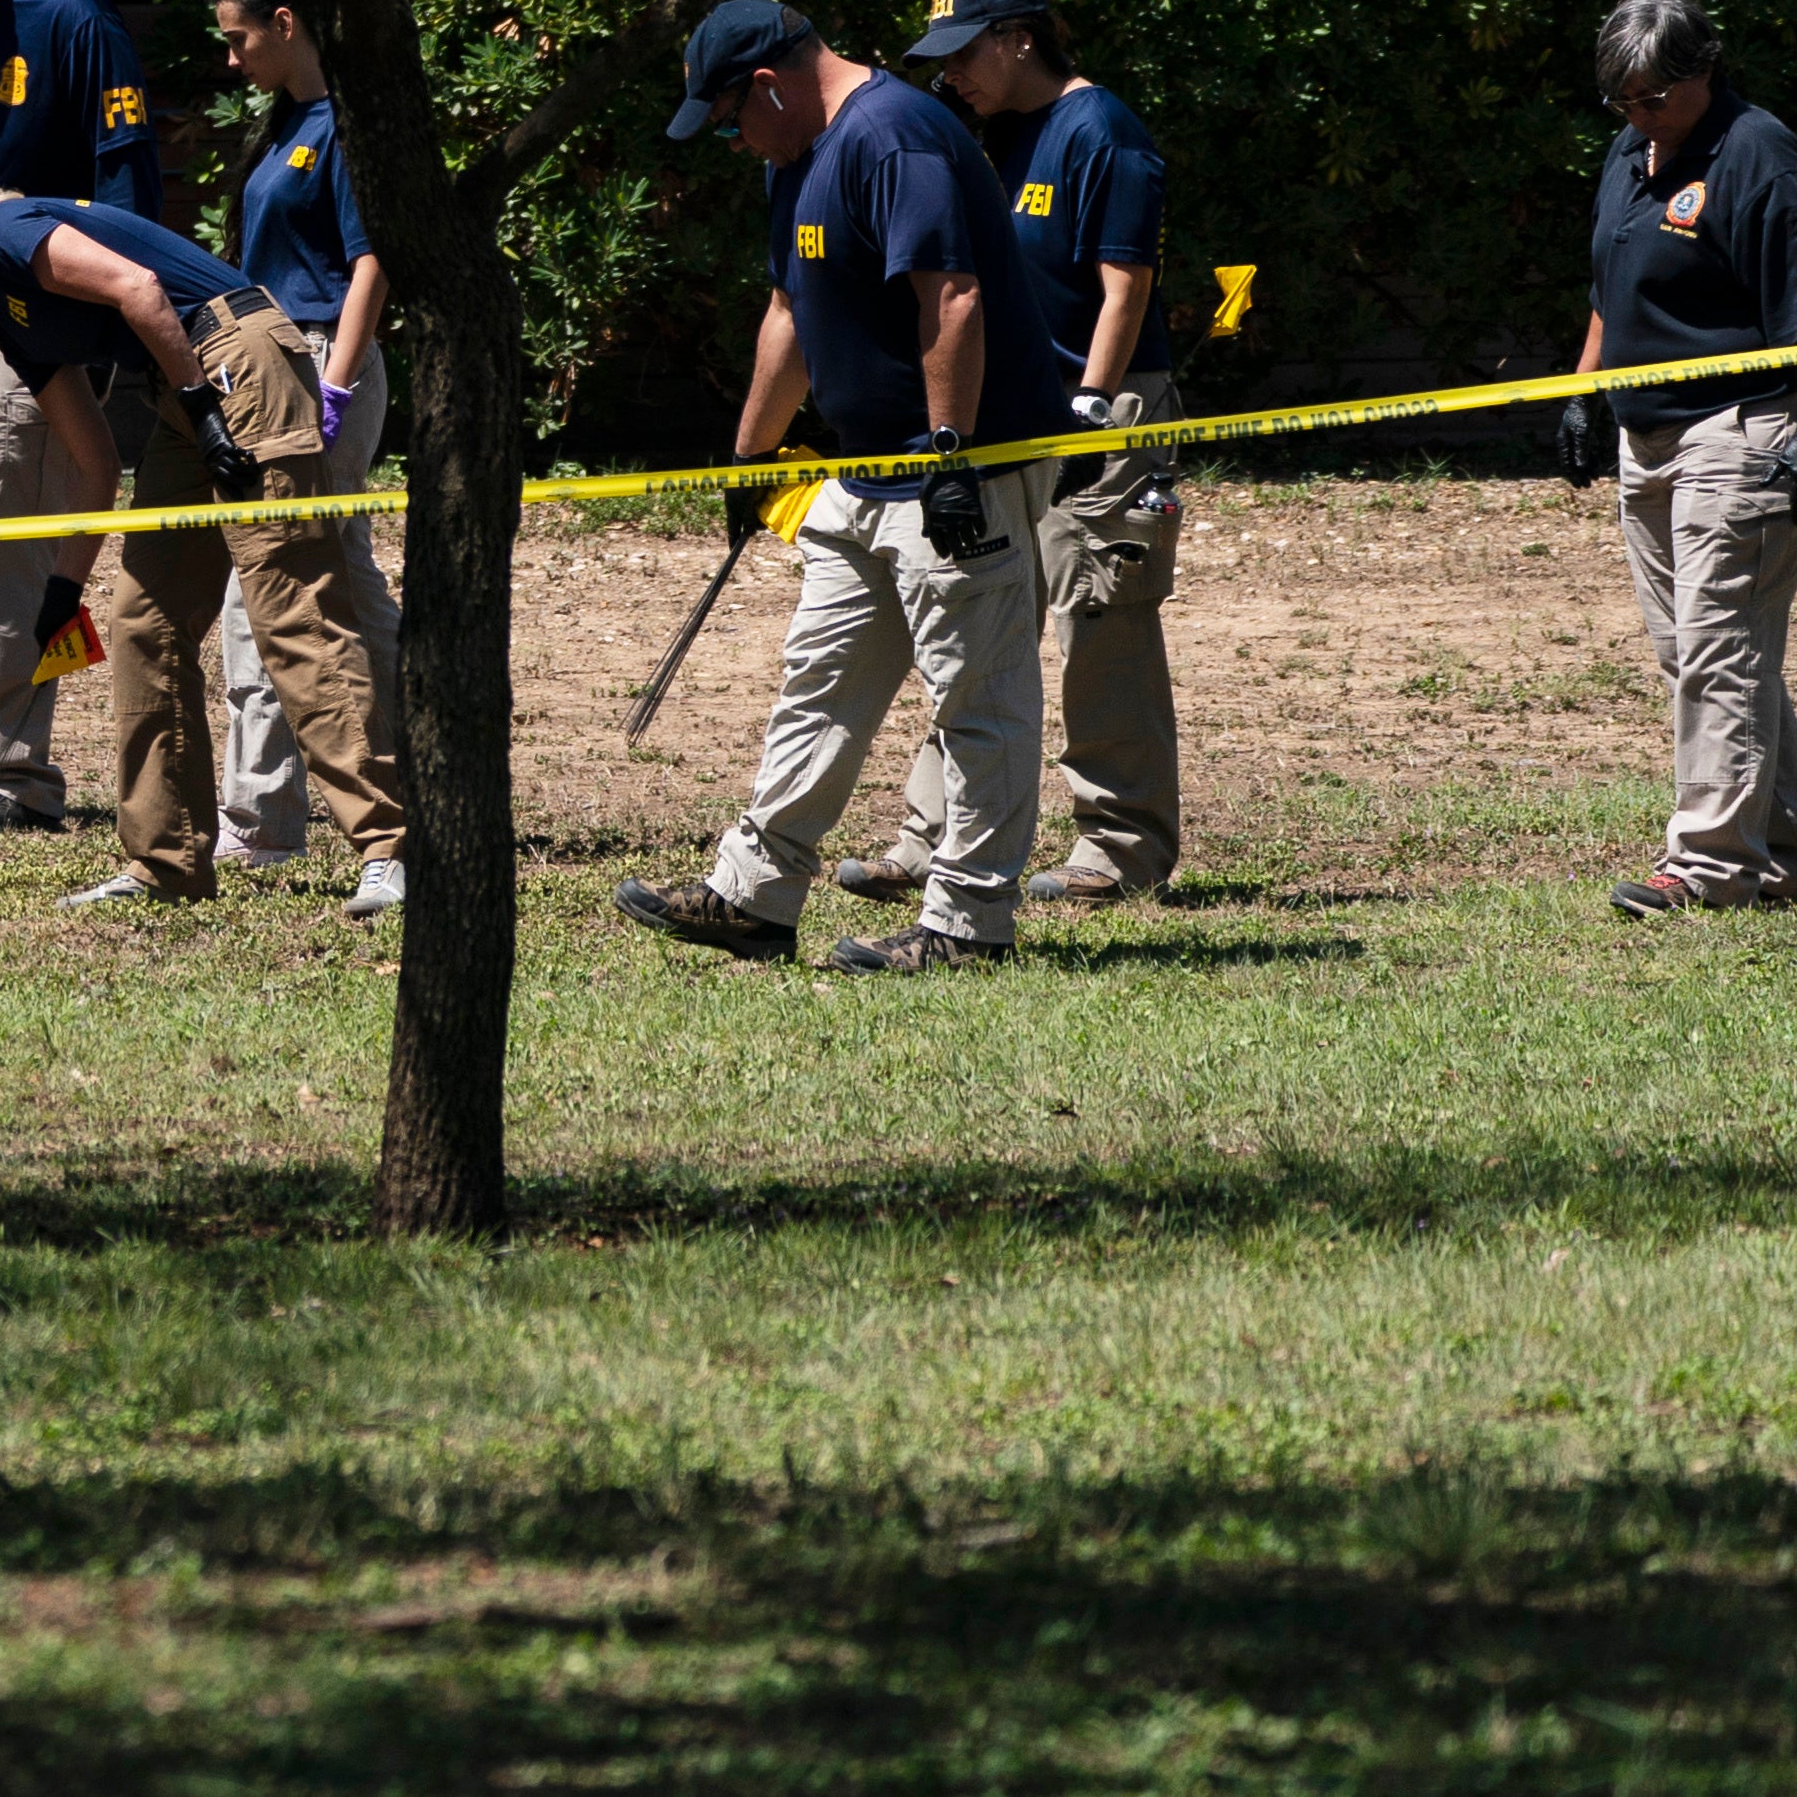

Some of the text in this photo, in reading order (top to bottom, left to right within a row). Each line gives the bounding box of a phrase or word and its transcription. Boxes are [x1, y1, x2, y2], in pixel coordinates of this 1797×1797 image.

[102, 86, 148, 129] FBI
[1014, 183, 1054, 217] FBI
[797, 224, 825, 259] FBI
